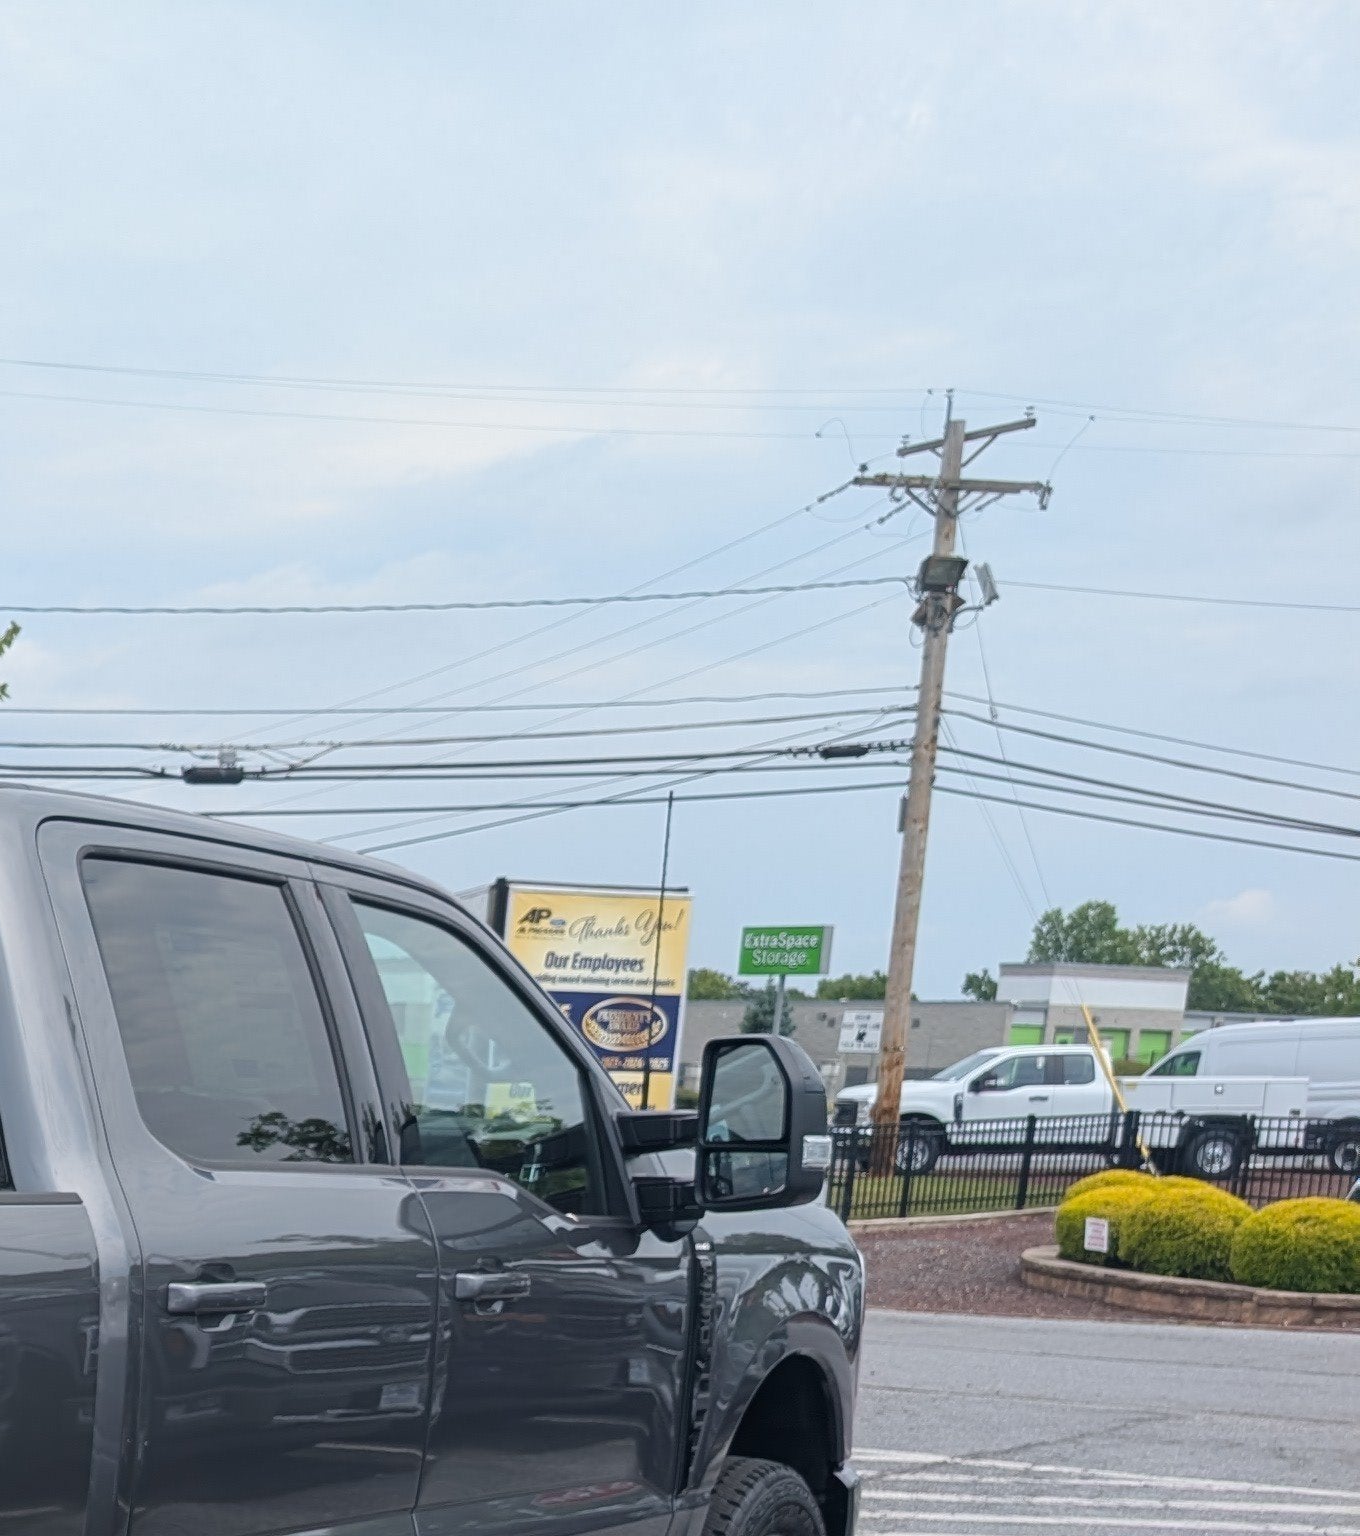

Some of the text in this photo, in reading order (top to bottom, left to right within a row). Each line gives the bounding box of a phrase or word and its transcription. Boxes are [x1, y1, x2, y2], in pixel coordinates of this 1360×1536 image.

[568, 914, 630, 944] Thanks
[544, 951, 645, 973] Our Employees
[752, 948, 807, 969] Storage
